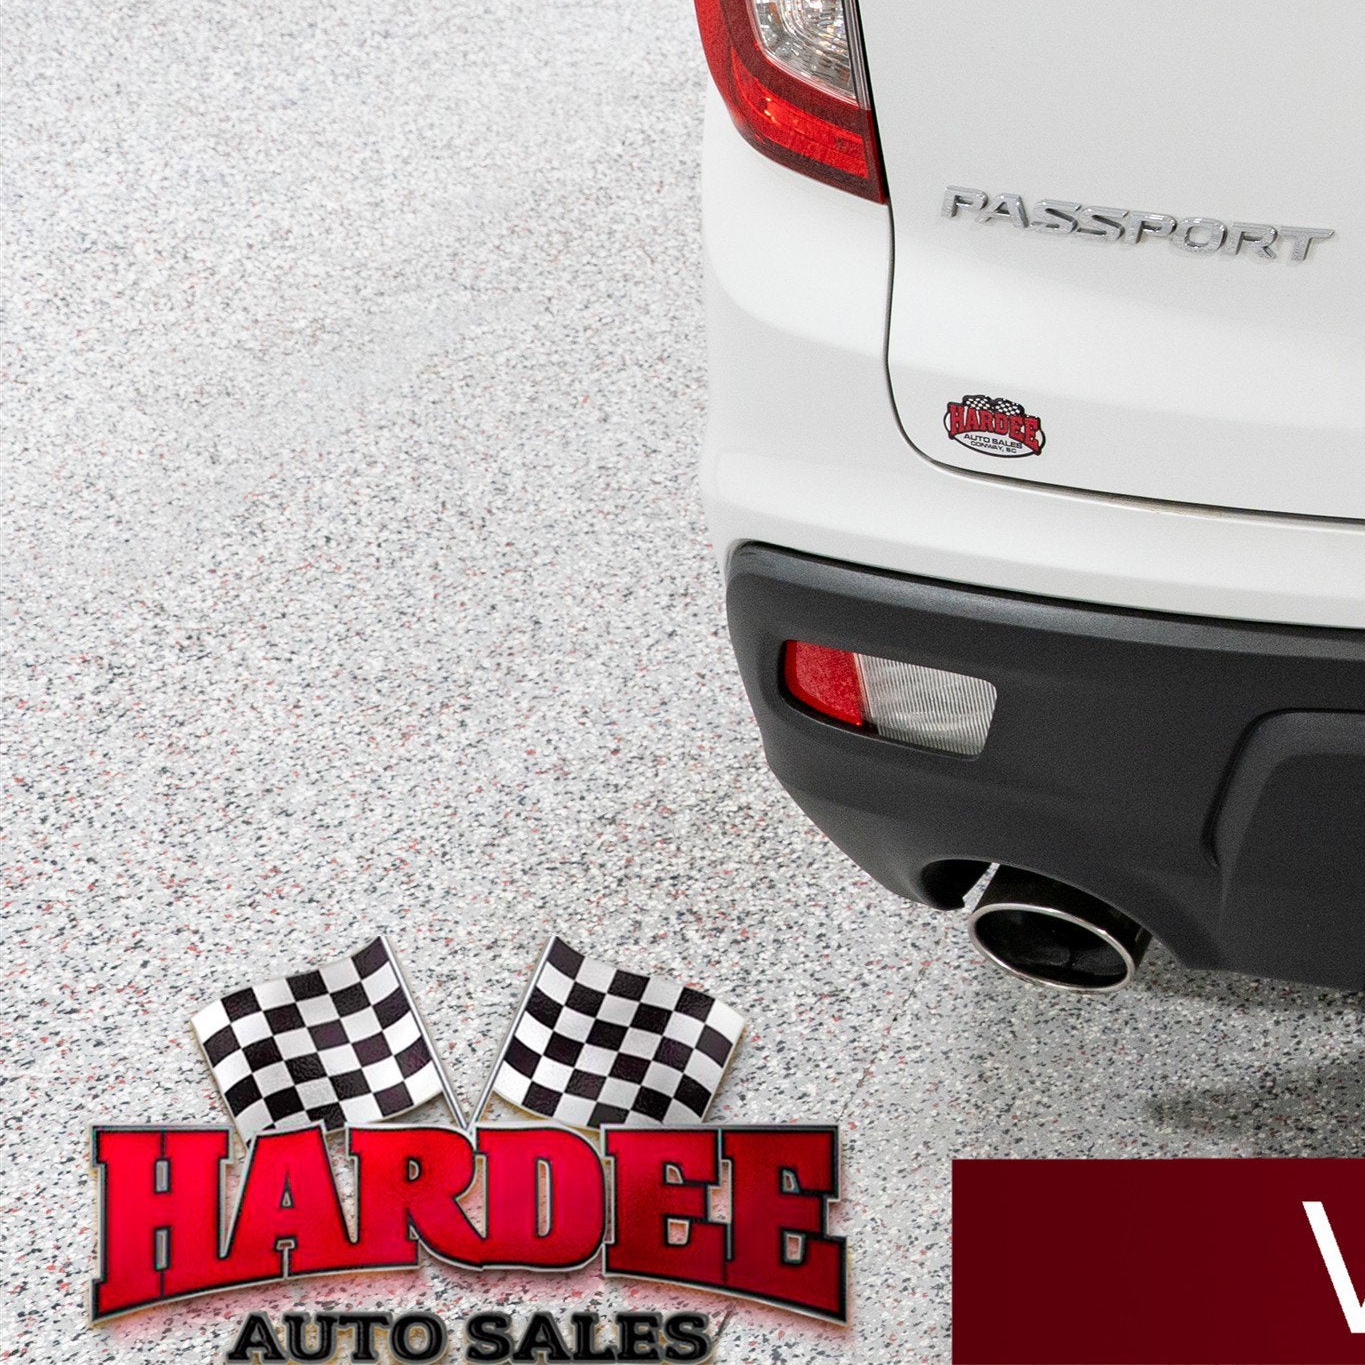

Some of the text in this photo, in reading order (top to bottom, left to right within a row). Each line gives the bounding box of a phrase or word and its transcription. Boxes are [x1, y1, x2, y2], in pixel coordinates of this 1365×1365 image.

[939, 184, 1336, 263] PASSPORT
[947, 402, 1041, 455] HARDEE
[964, 433, 1024, 450] AUTO SALES
